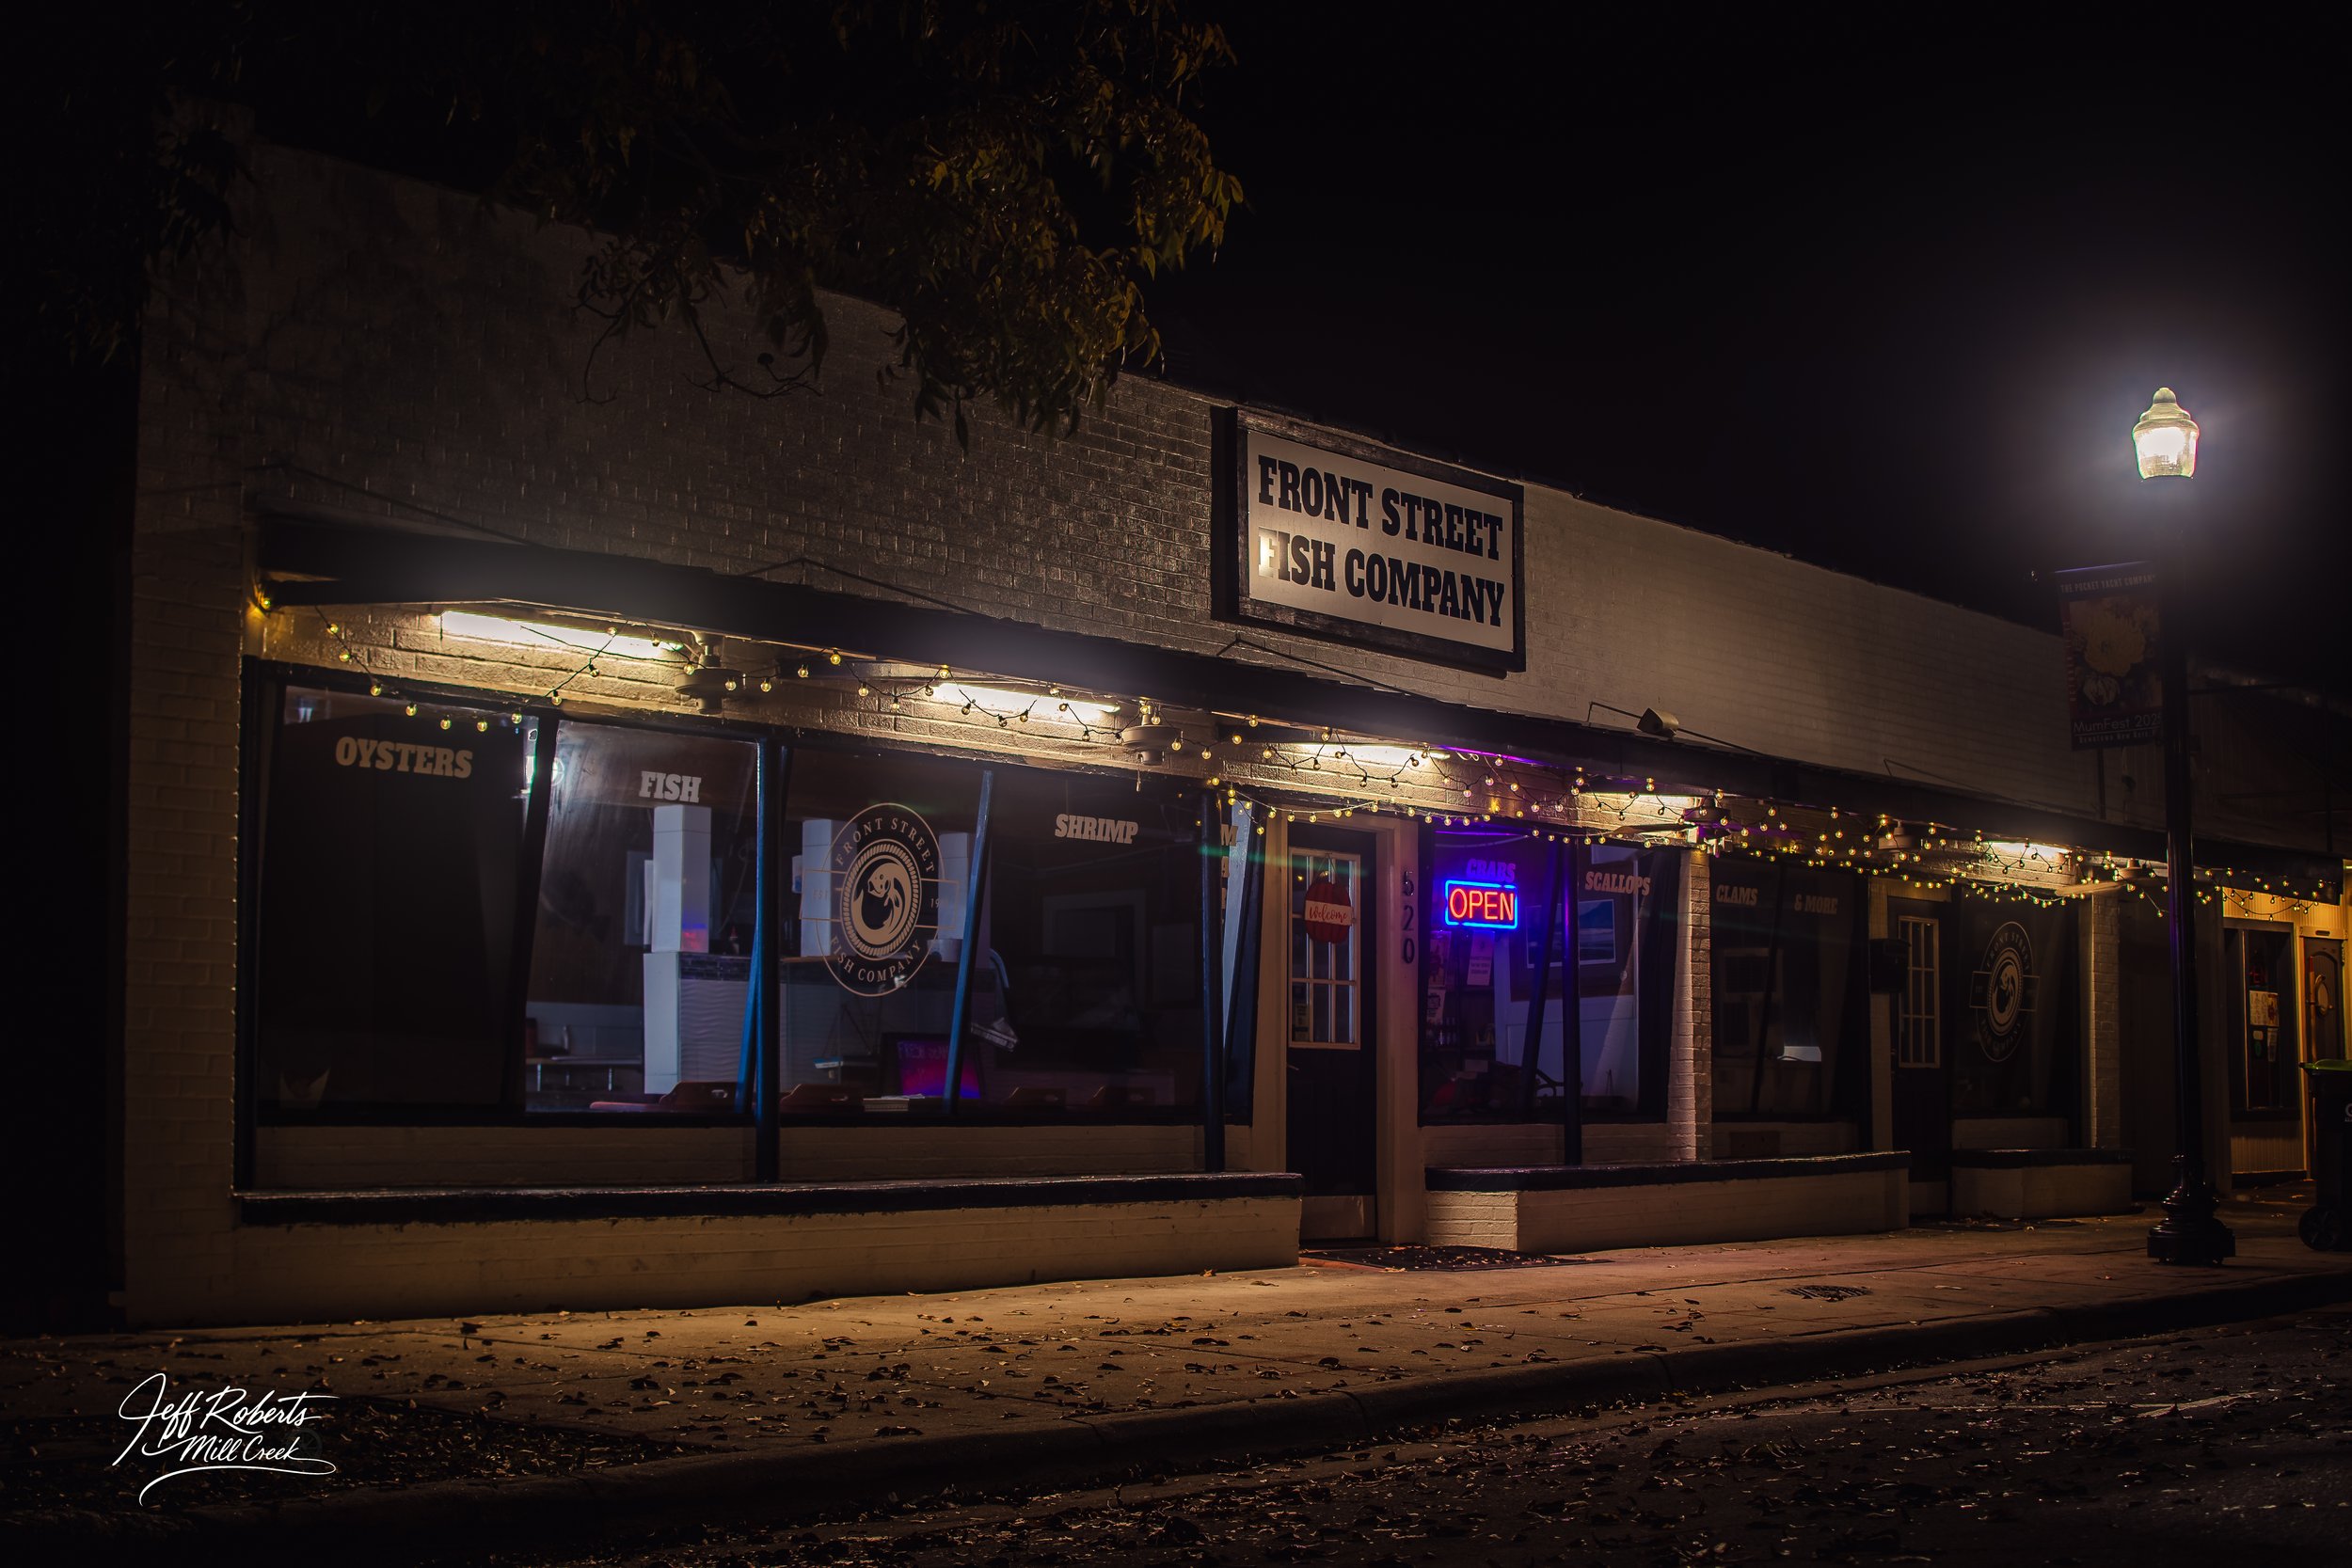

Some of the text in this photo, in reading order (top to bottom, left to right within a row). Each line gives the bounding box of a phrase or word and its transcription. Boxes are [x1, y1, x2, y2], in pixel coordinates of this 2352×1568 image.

[1258, 454, 1503, 561] FRONT STREET
[1258, 527, 1504, 627] FISH COMPANY
[2124, 574, 2156, 586] COMPAN
[2073, 718, 2130, 733] MumFest
[335, 736, 473, 779] OYSTERS
[639, 770, 703, 803] FISH
[834, 817, 935, 873] FRONT STREET
[1054, 814, 1138, 845] SHRIMP
[1585, 871, 1652, 896] SCALLOPS
[1716, 884, 1758, 907] CLAMS
[1309, 906, 1348, 924] Welcome
[1450, 888, 1515, 921] OPEN
[1794, 894, 1839, 915] & MORE
[831, 935, 922, 985] FISH COMPANY
